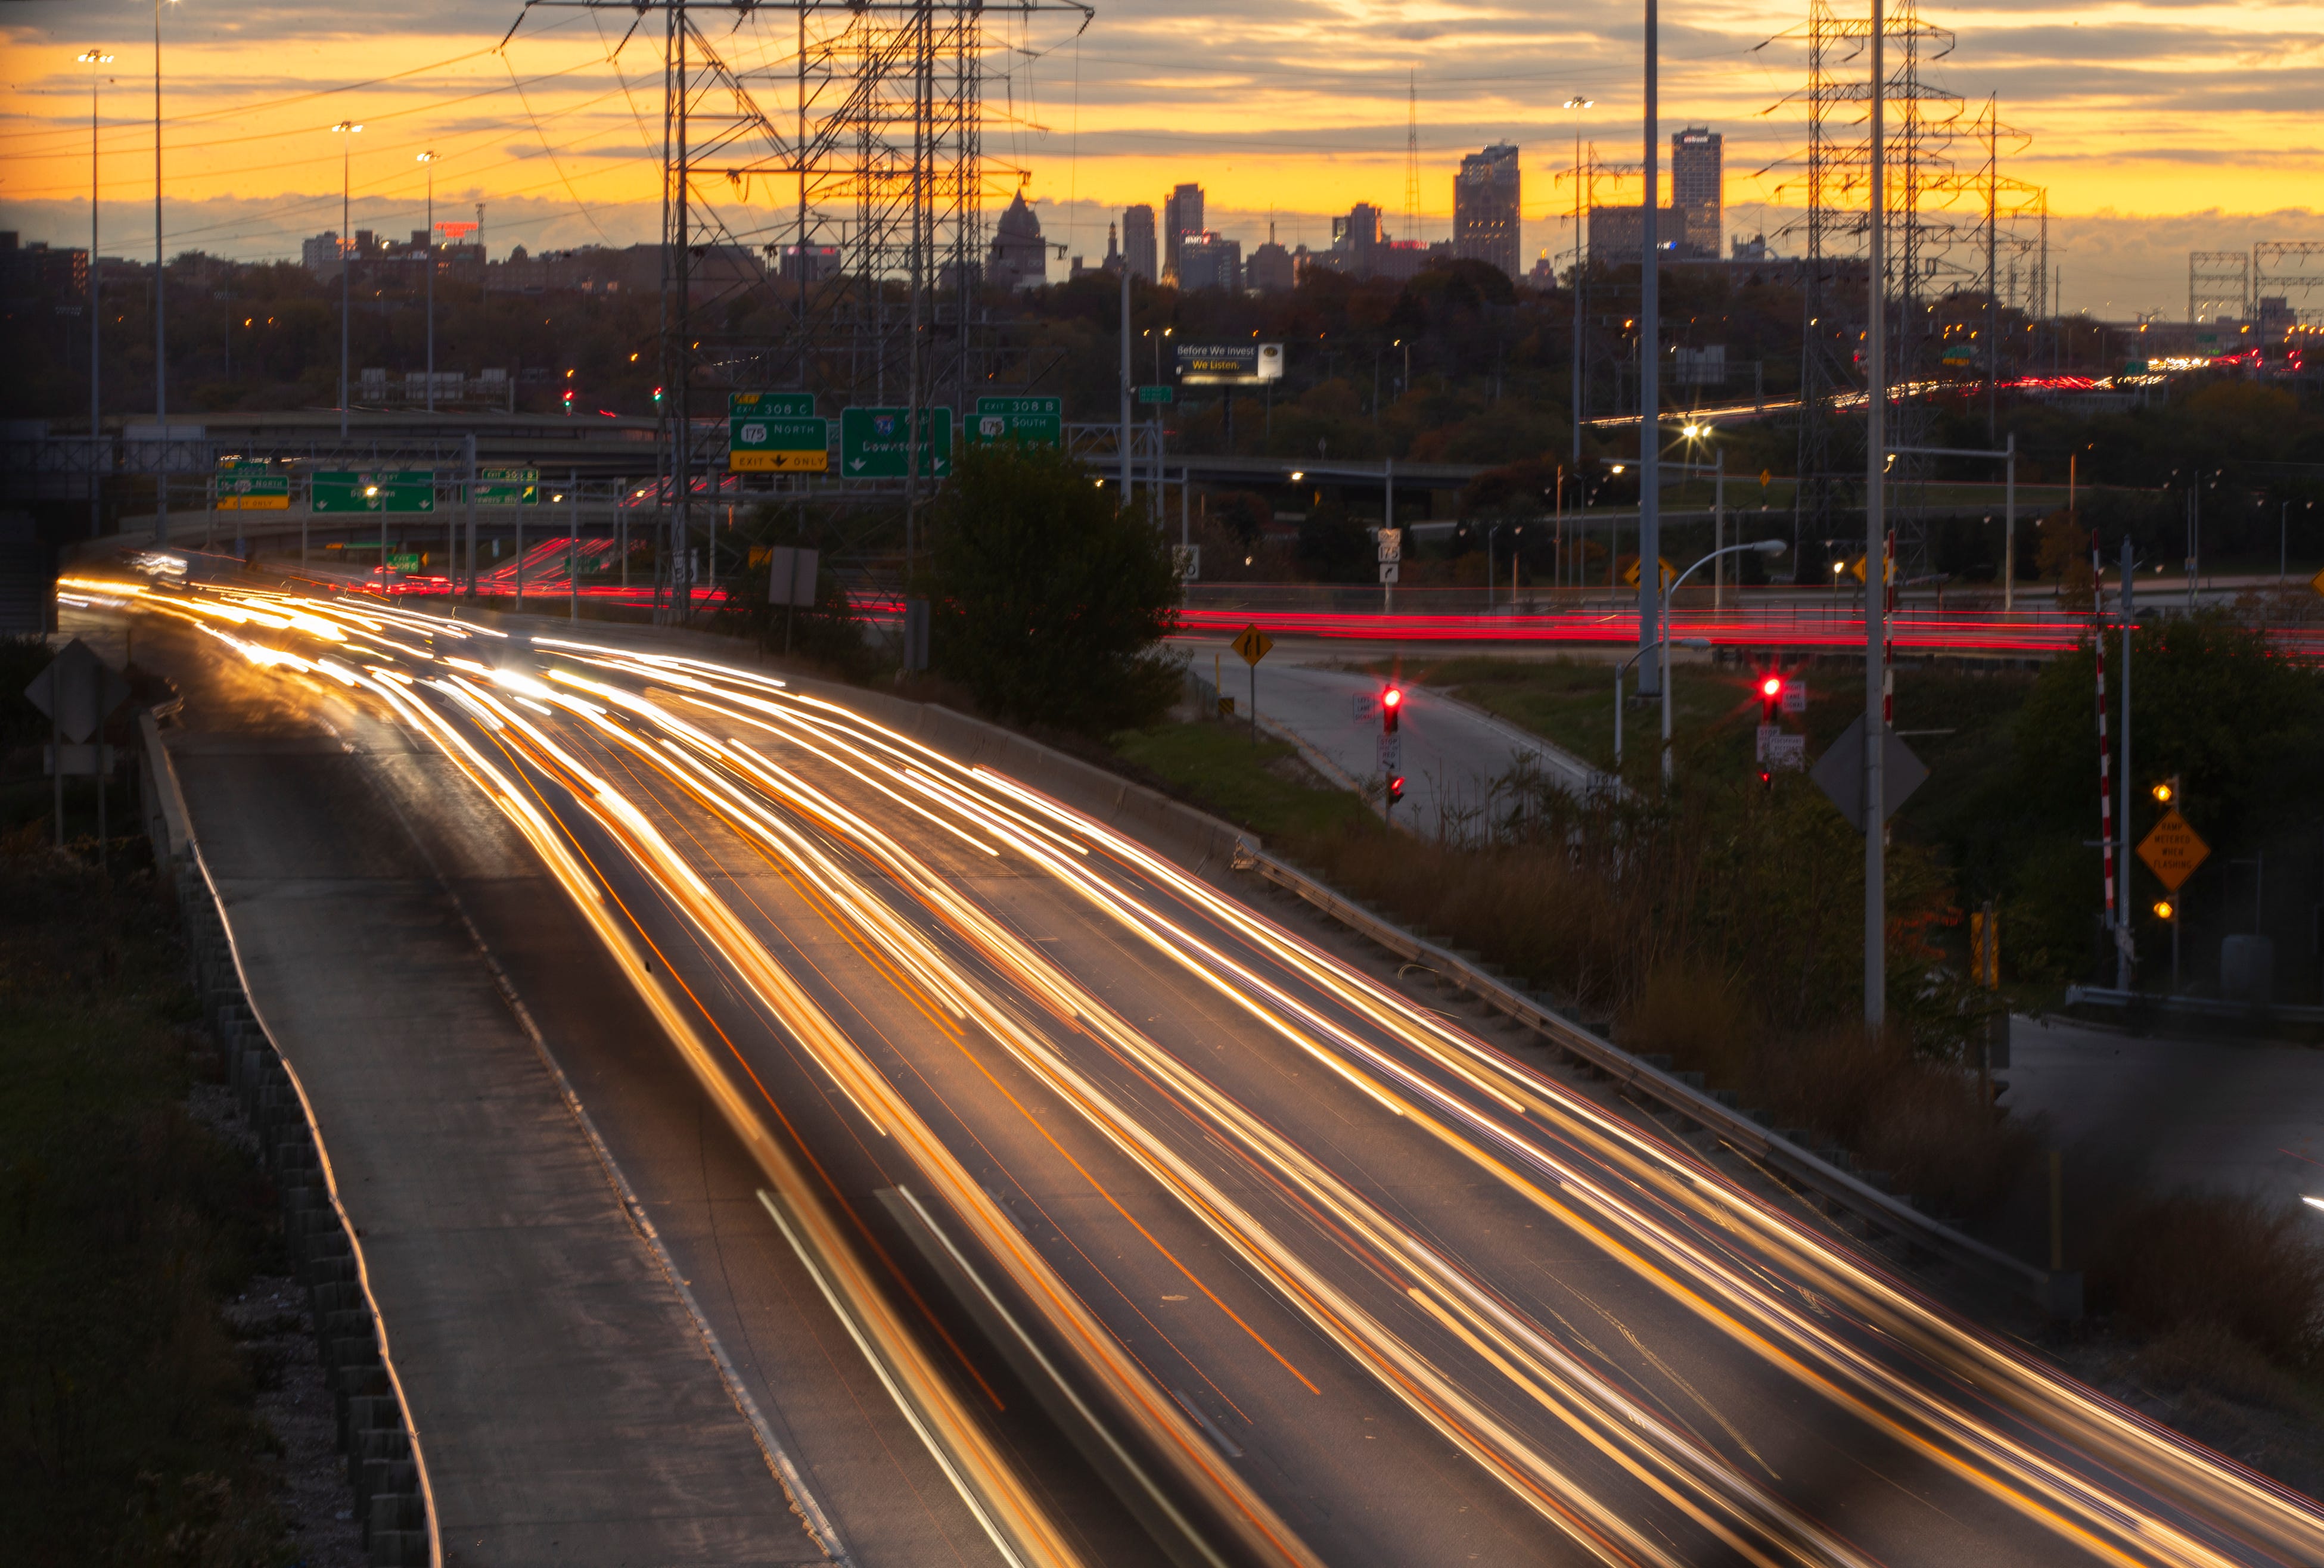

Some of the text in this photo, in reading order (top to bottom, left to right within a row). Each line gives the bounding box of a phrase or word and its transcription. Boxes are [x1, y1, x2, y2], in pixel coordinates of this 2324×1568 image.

[1177, 344, 1207, 356] Before
[1210, 345, 1225, 356] We
[1228, 346, 1254, 356] Invest
[1193, 360, 1208, 370] We
[765, 404, 791, 415] 308
[799, 404, 807, 414] C
[1013, 401, 1039, 412] 308
[1046, 402, 1054, 412] B
[1012, 416, 1046, 427] SOUTH
[745, 424, 814, 440] 175 NORTH
[740, 457, 825, 466] EXIT ONLY
[1380, 546, 1398, 559] 175
[2154, 835, 2191, 844] METERED
[2162, 848, 2183, 856] WHEN
[2154, 860, 2192, 869] FLASHING
